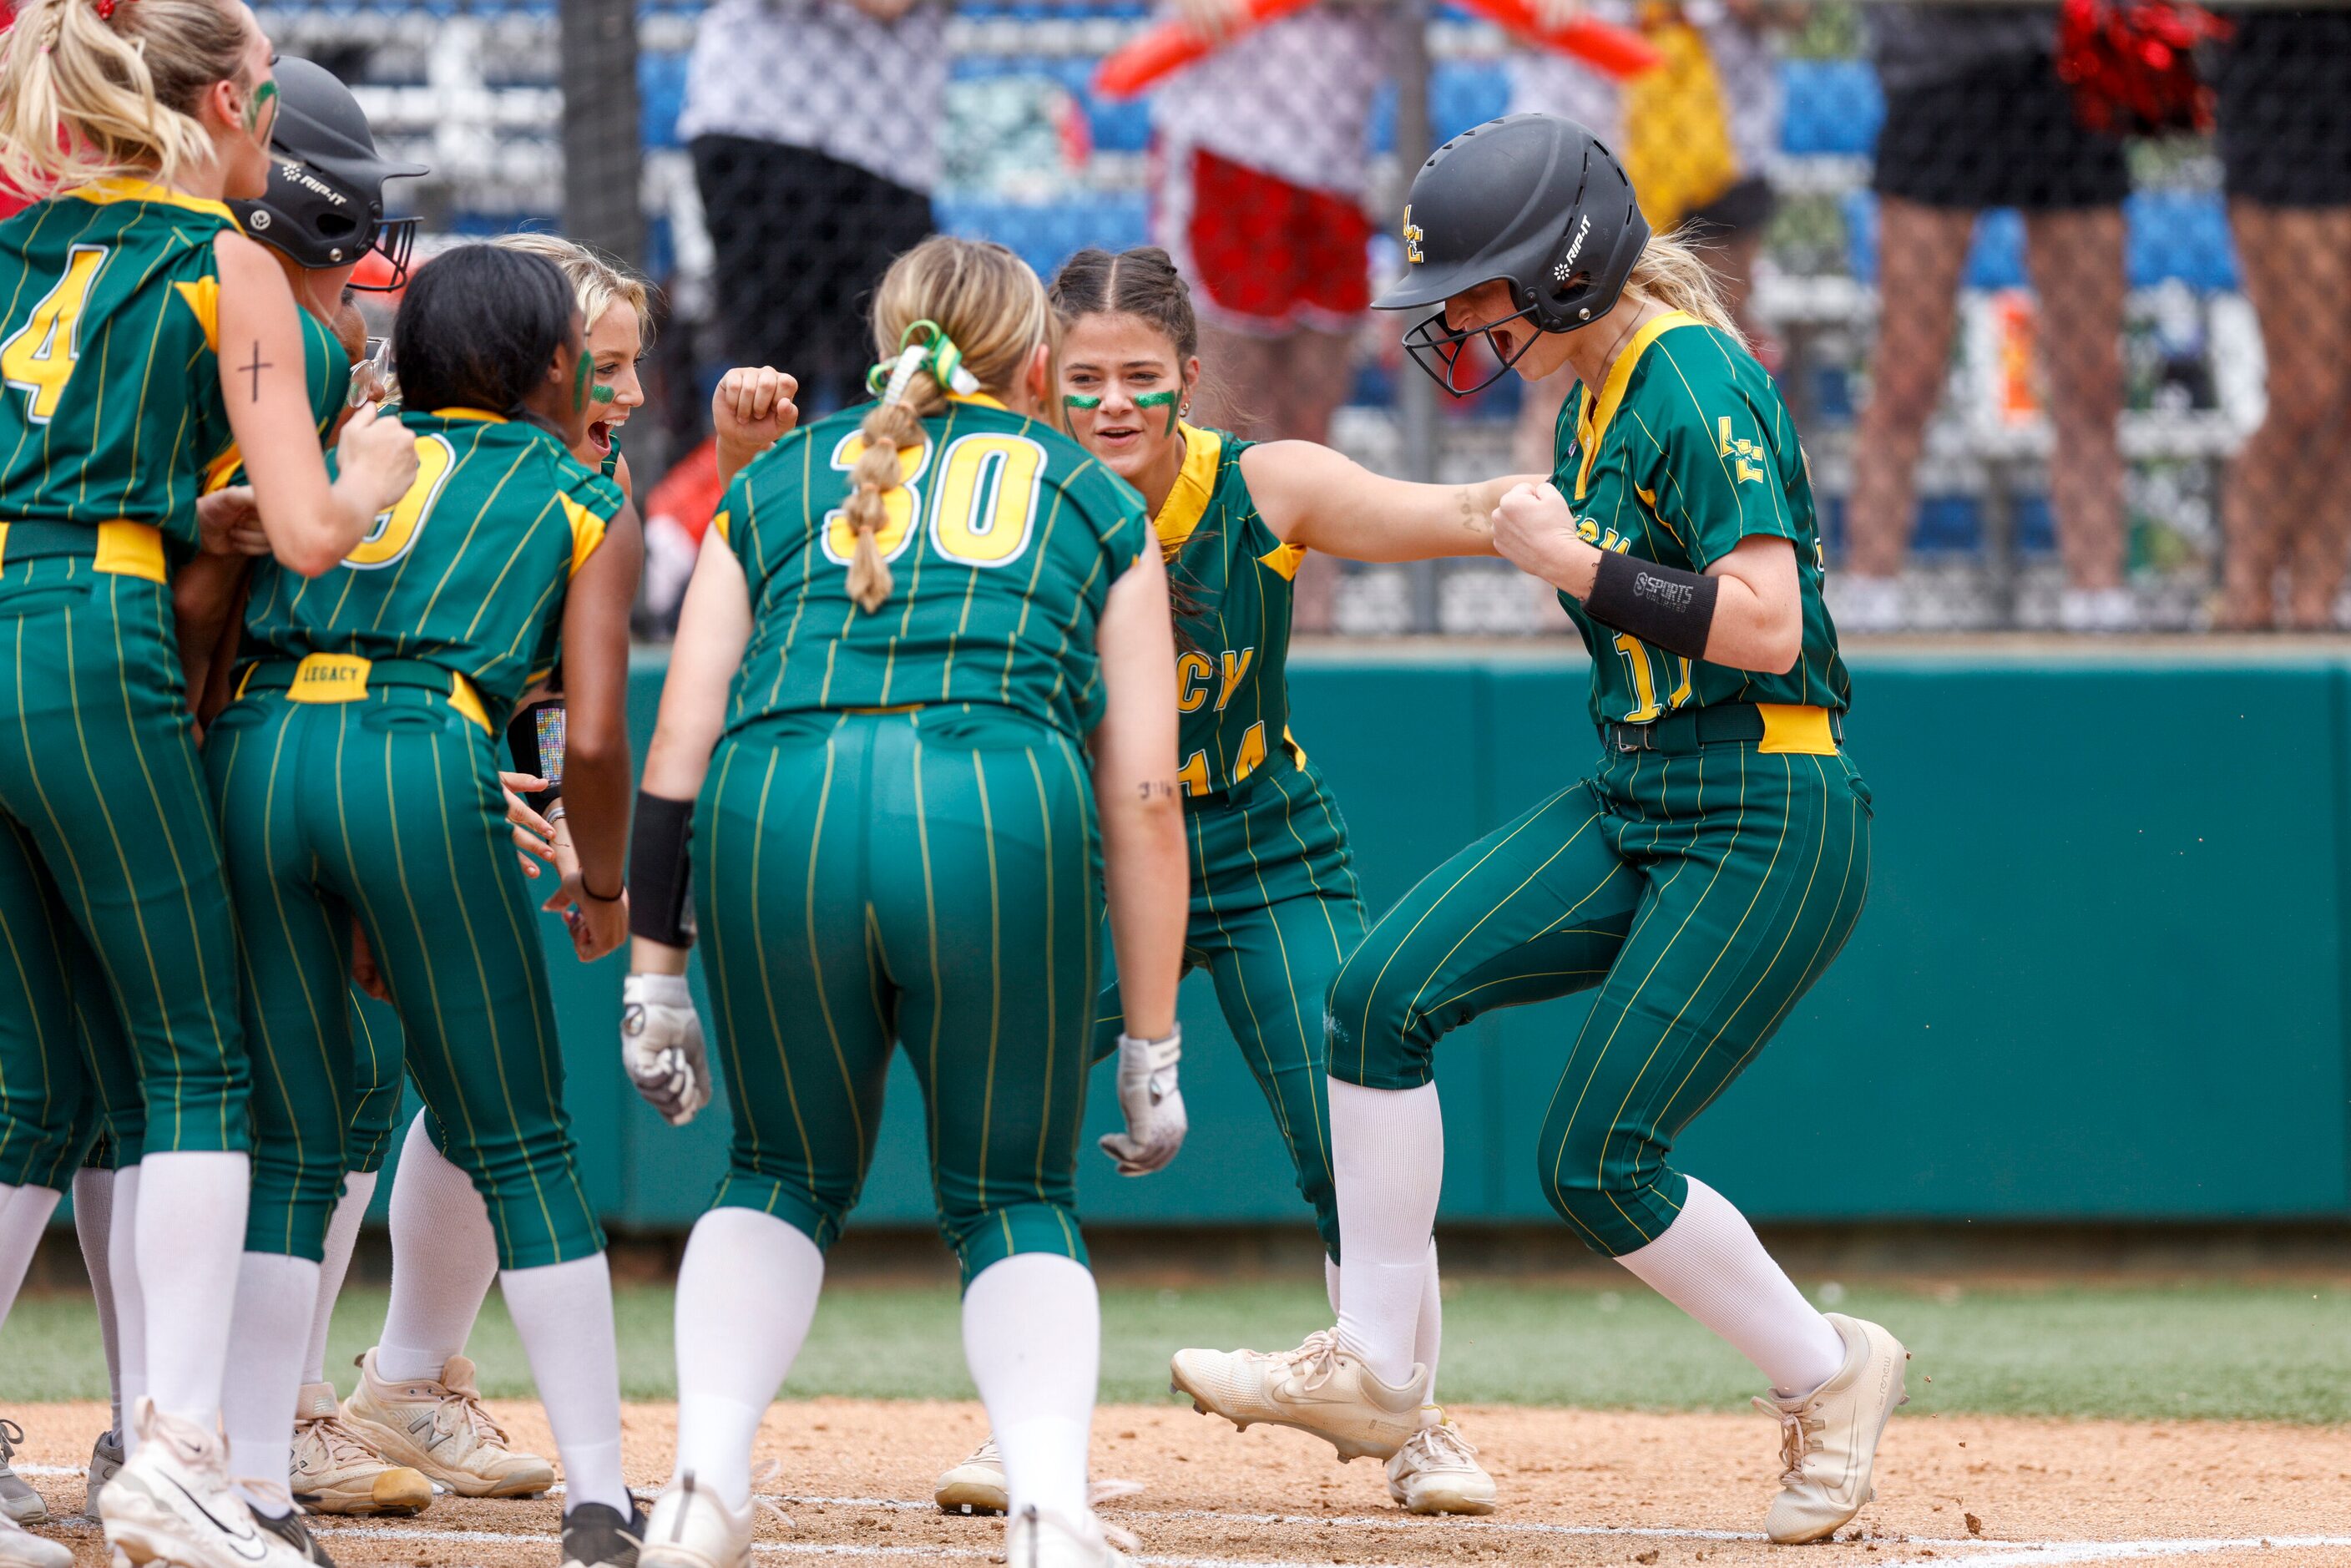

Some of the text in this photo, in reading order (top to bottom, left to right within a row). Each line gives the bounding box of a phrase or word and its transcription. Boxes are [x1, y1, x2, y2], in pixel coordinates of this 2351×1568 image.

[0, 244, 109, 424] 4
[821, 429, 1048, 568] 30
[1646, 577, 1693, 604] SPORTS
[304, 667, 357, 681] LEGACY
